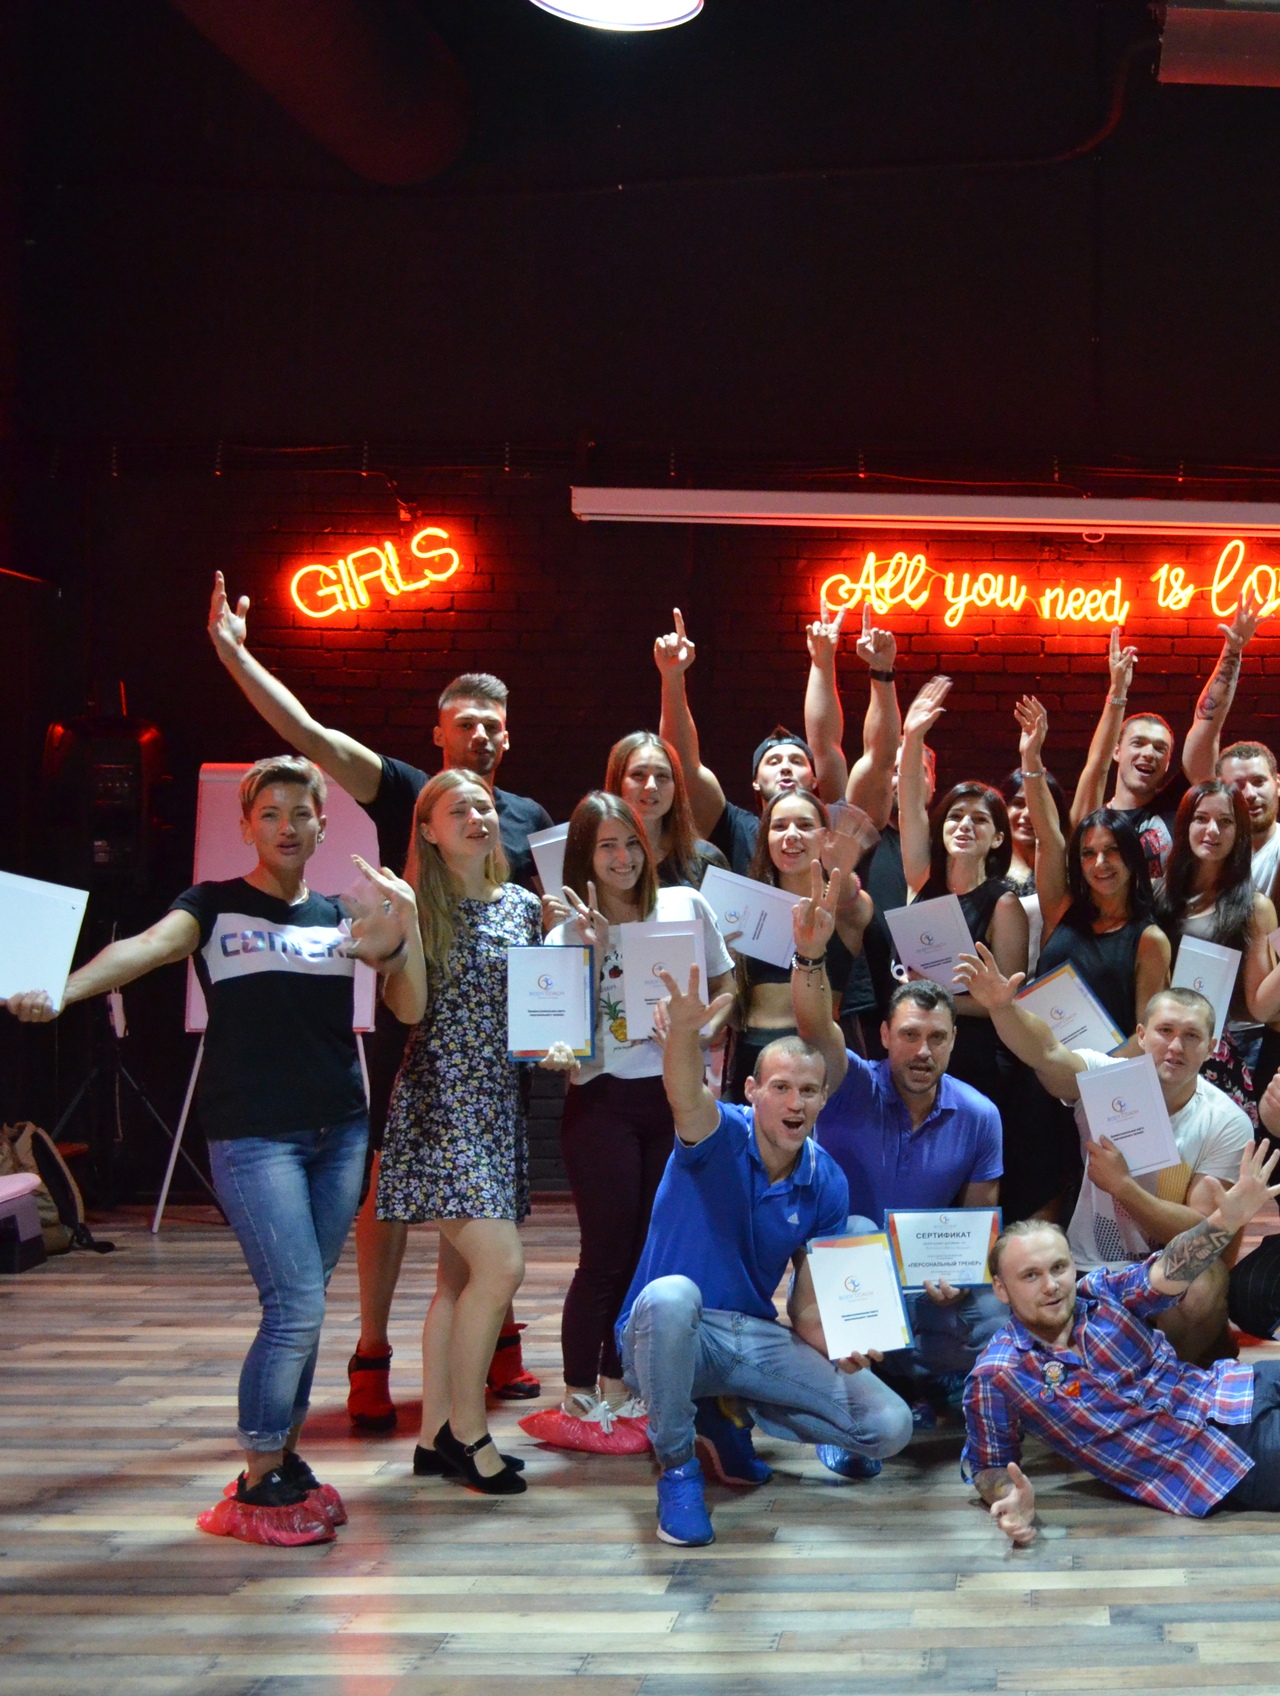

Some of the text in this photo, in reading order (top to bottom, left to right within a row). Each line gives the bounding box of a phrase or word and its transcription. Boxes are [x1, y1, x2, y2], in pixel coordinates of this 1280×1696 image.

[291, 526, 461, 618] GIRLS
[820, 551, 929, 615] All
[943, 571, 1027, 627] you
[1040, 577, 1130, 625] need
[1150, 563, 1194, 610] is
[916, 1231, 971, 1239] СЕРТИФИКАТ
